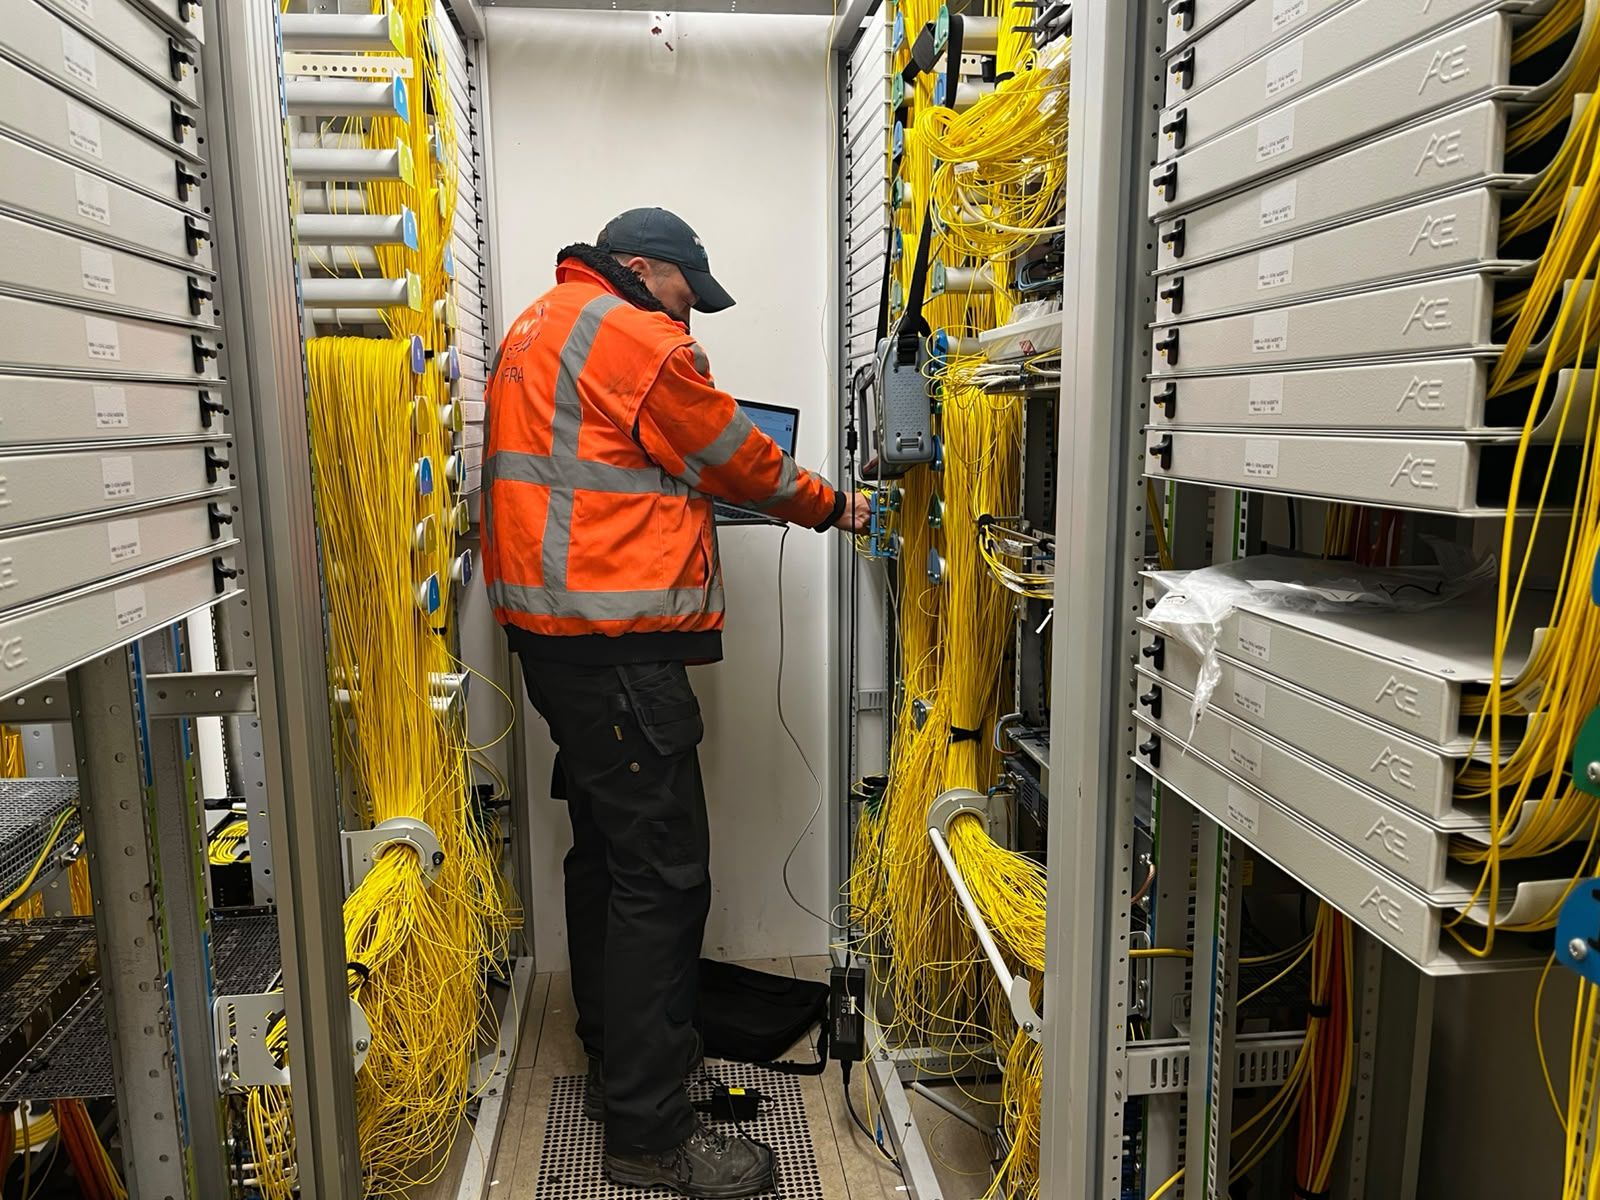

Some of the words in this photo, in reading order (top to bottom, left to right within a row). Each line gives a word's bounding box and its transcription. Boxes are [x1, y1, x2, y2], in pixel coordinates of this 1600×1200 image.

[1418, 44, 1469, 95] ACE
[1414, 129, 1463, 176] ACE
[1409, 214, 1458, 256] ACE
[1402, 296, 1451, 335] ACE
[1396, 376, 1444, 412] ACE
[1390, 452, 1437, 489] ACE
[1375, 675, 1420, 718] ACE
[1370, 746, 1415, 791] ACE
[1365, 816, 1409, 863] ACE
[1360, 885, 1404, 935] ACE
